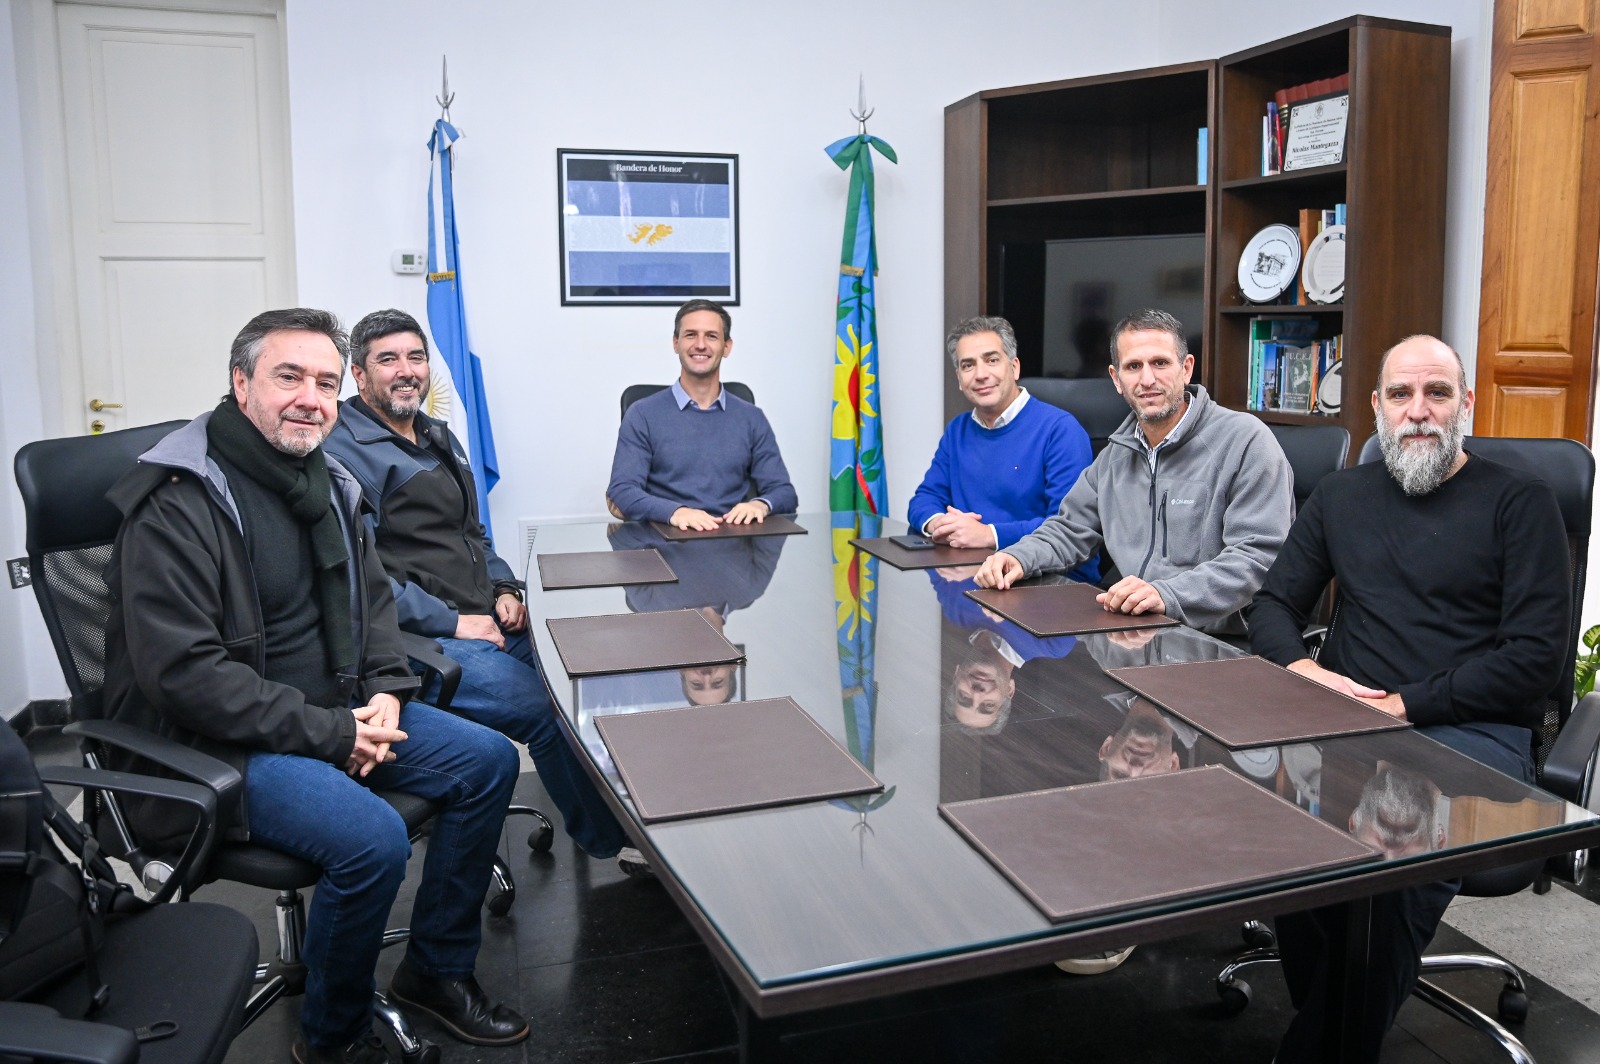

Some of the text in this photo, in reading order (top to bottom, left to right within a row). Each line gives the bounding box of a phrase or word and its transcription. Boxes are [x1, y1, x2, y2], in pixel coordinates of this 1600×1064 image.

[616, 163, 683, 173] Bandera de Honor
